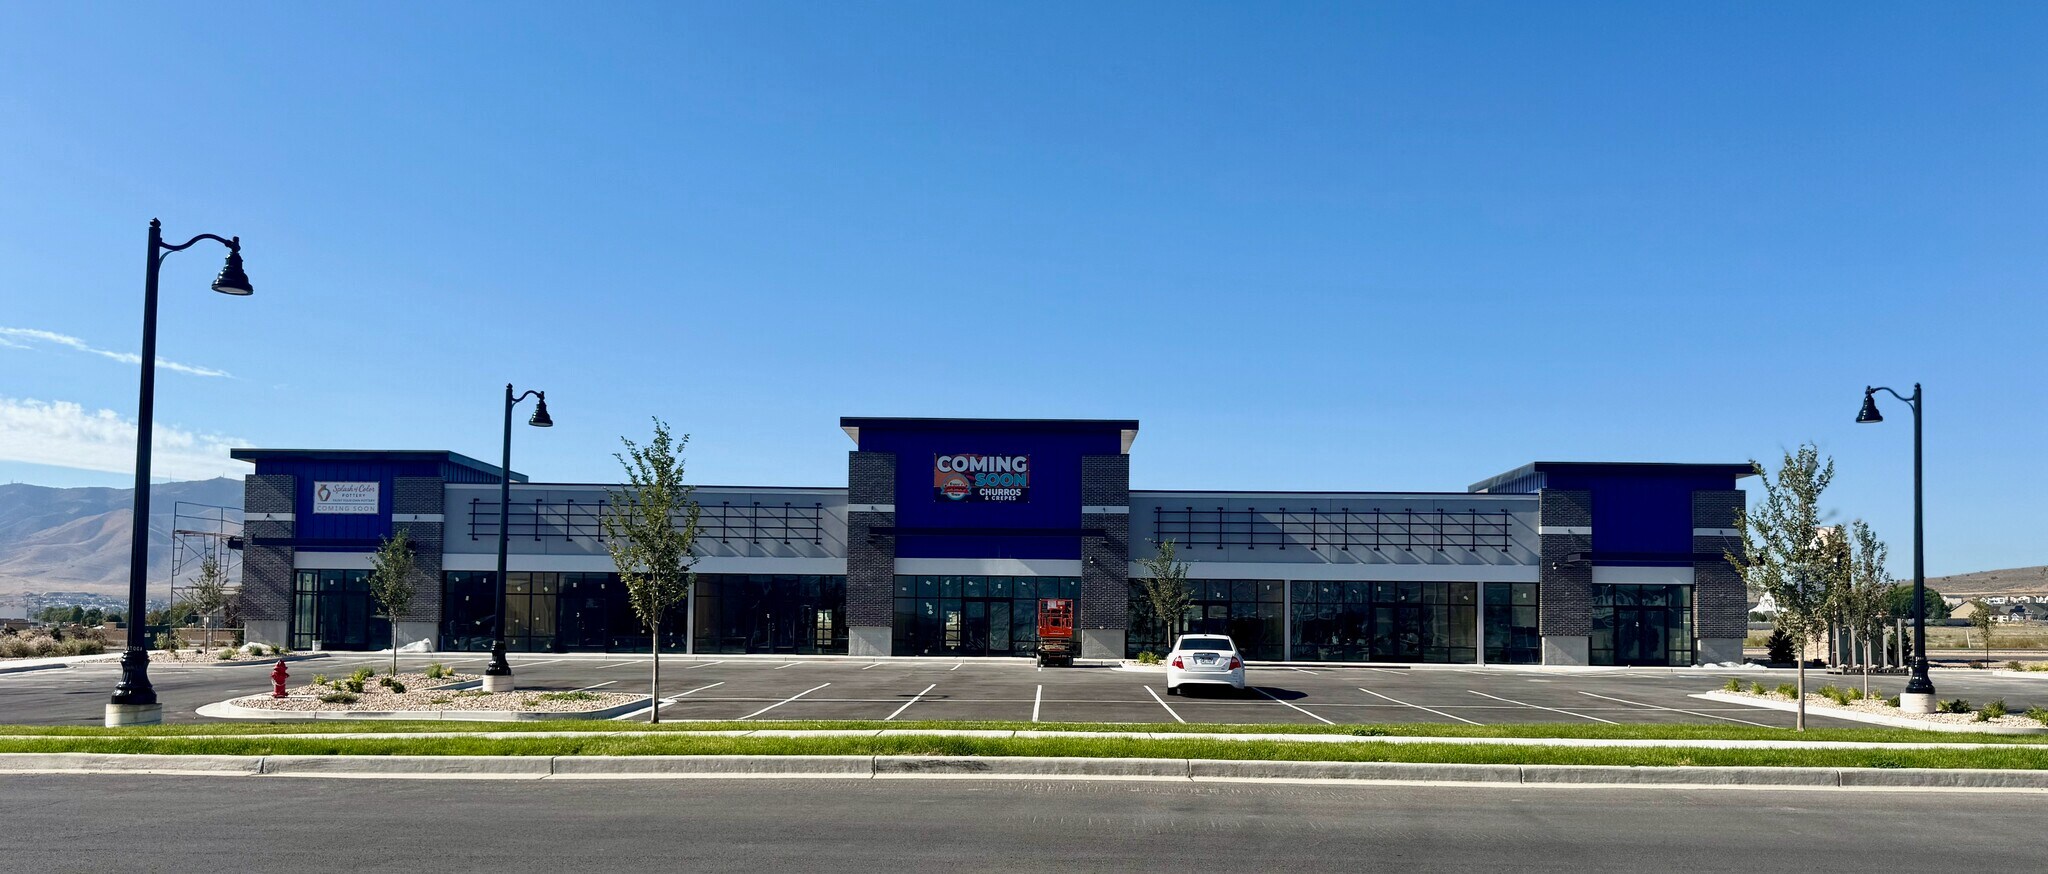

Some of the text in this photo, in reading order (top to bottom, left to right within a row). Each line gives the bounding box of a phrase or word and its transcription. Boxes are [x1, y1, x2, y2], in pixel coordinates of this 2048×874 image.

[937, 456, 1027, 472] COMING
[975, 473, 1026, 487] SOON
[333, 484, 353, 494] Splash
[359, 484, 375, 492] Color
[979, 488, 1021, 496] CHURROS
